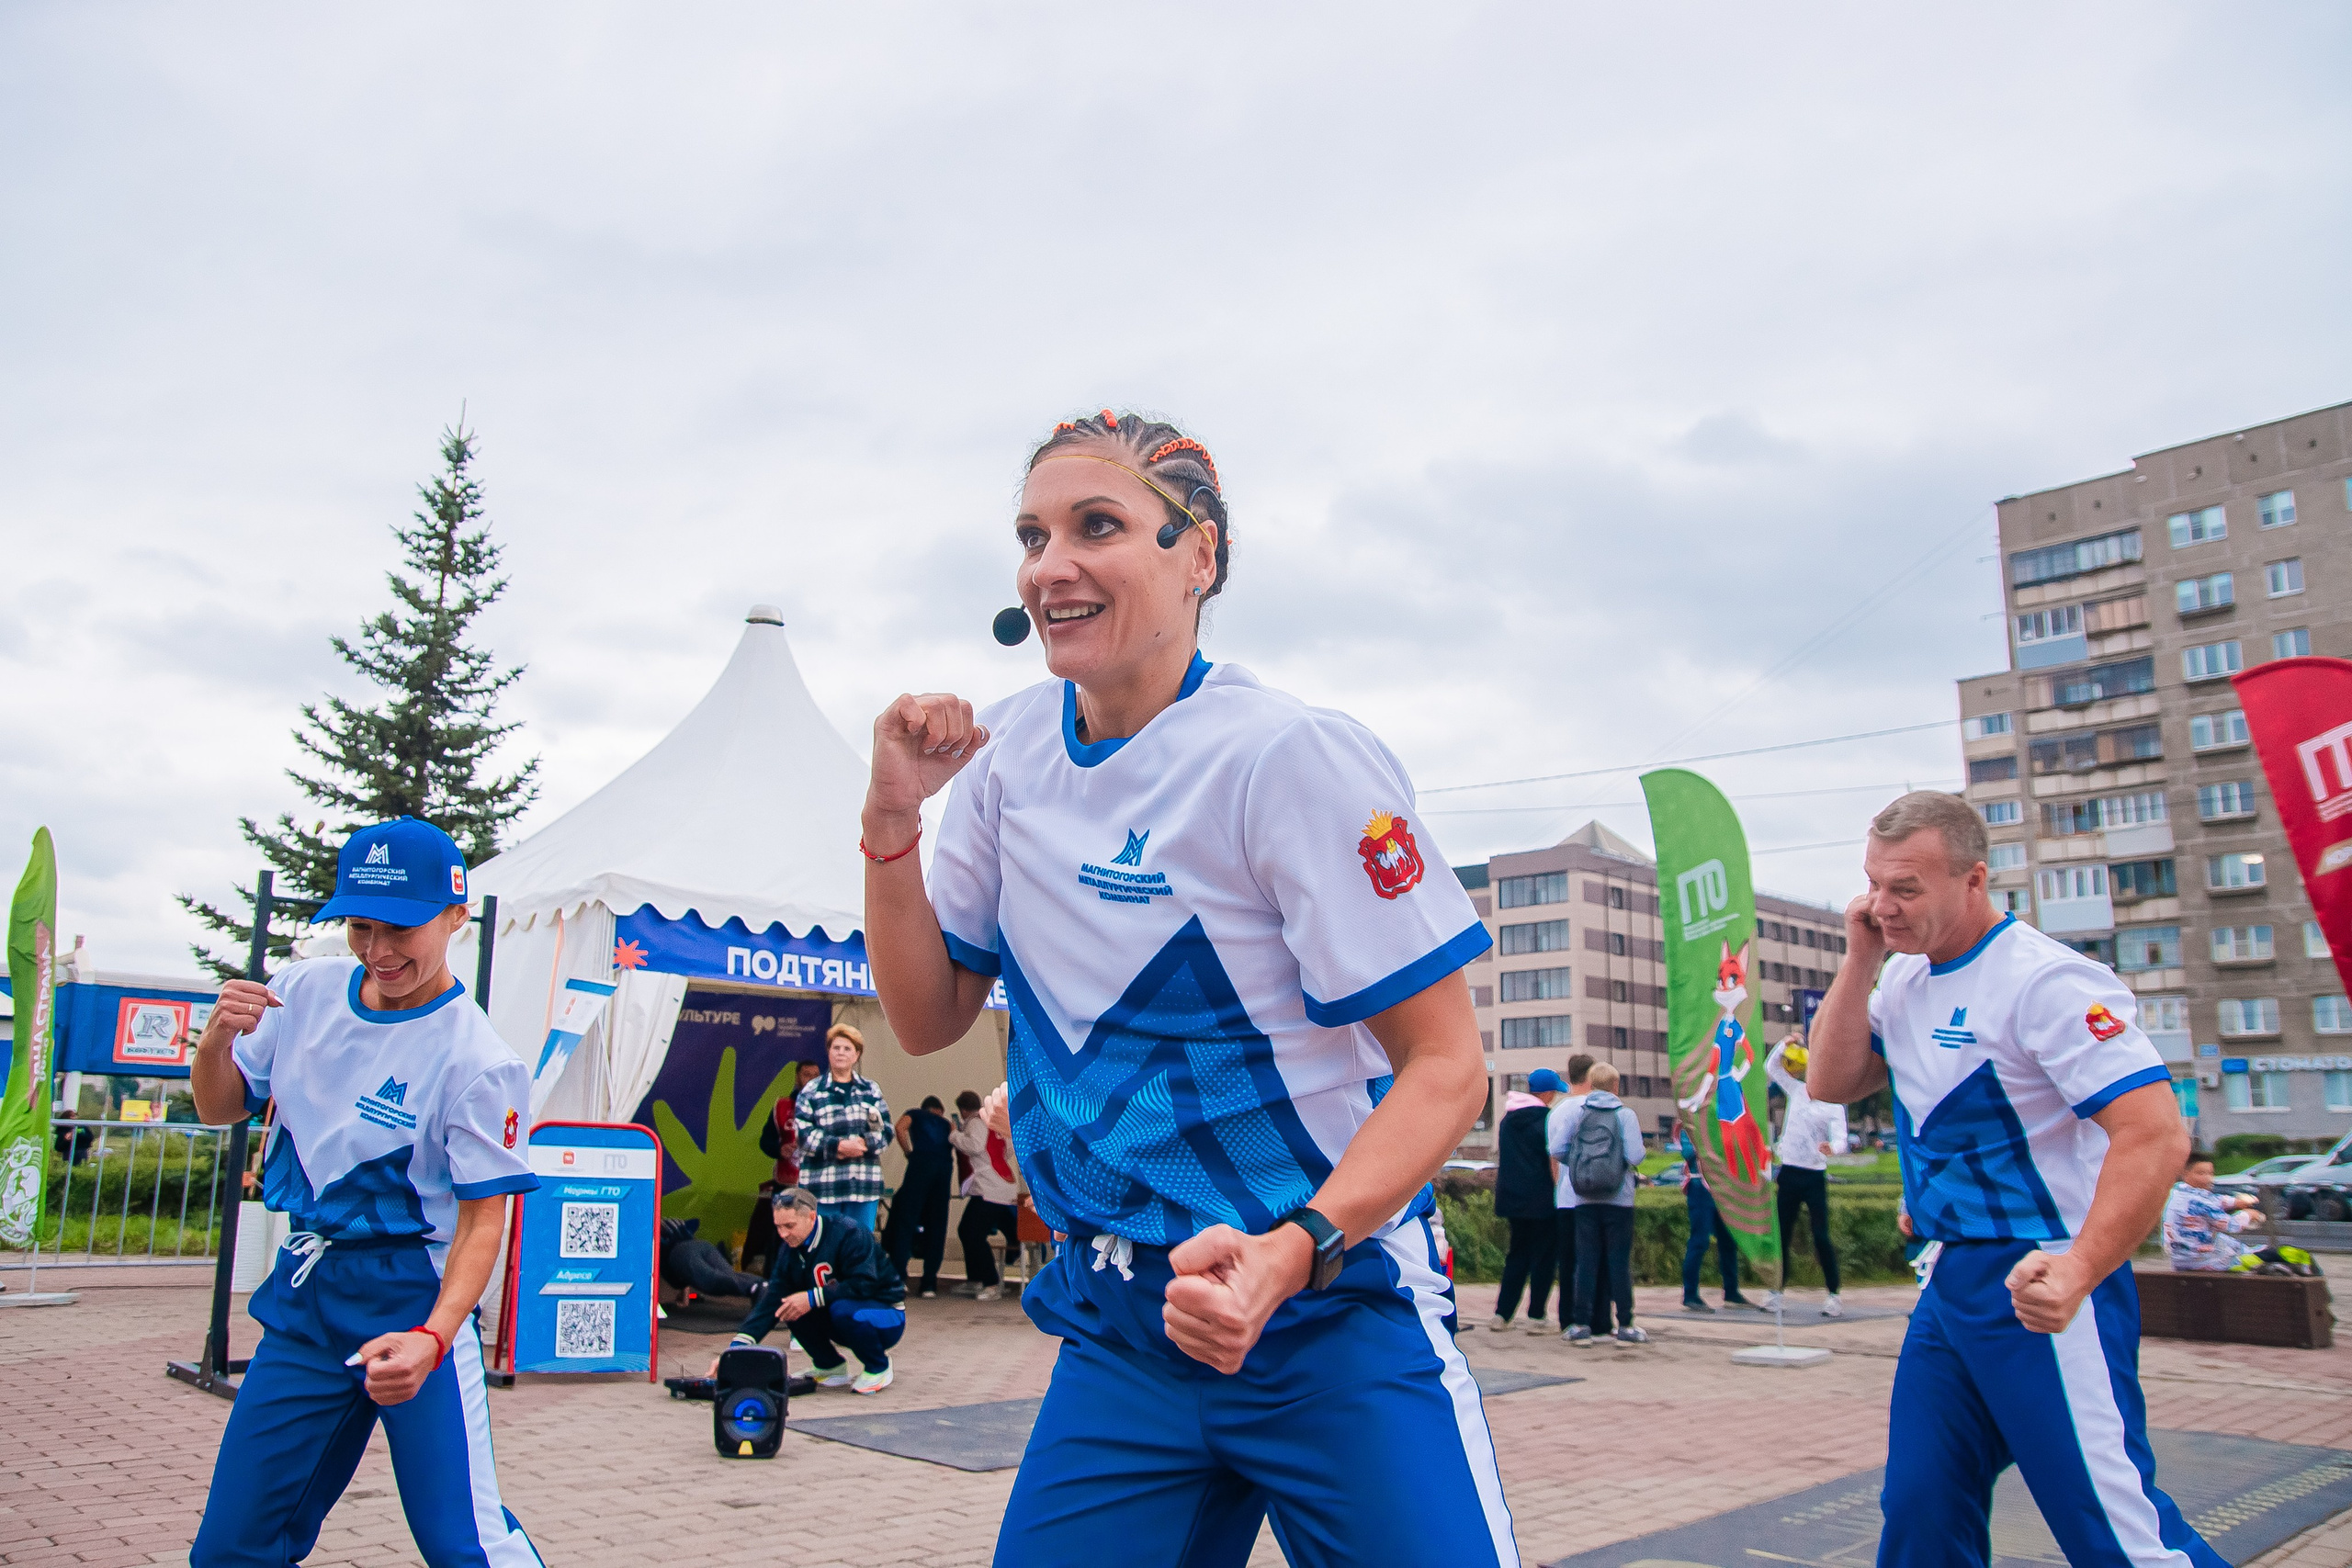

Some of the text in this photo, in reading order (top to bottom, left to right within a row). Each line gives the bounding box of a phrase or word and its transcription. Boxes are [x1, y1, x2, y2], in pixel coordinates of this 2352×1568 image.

[2297, 721, 2352, 802] ГТ
[1080, 863, 1167, 885] МАГНИТОГОРСКИЙ
[1078, 874, 1173, 897] МЕТАЛЛУРГИЧЕСКИЙ
[1677, 858, 1728, 925] ГТО
[1098, 890, 1150, 905] КОМБИНАТ
[600, 1186, 622, 1197] ГТО
